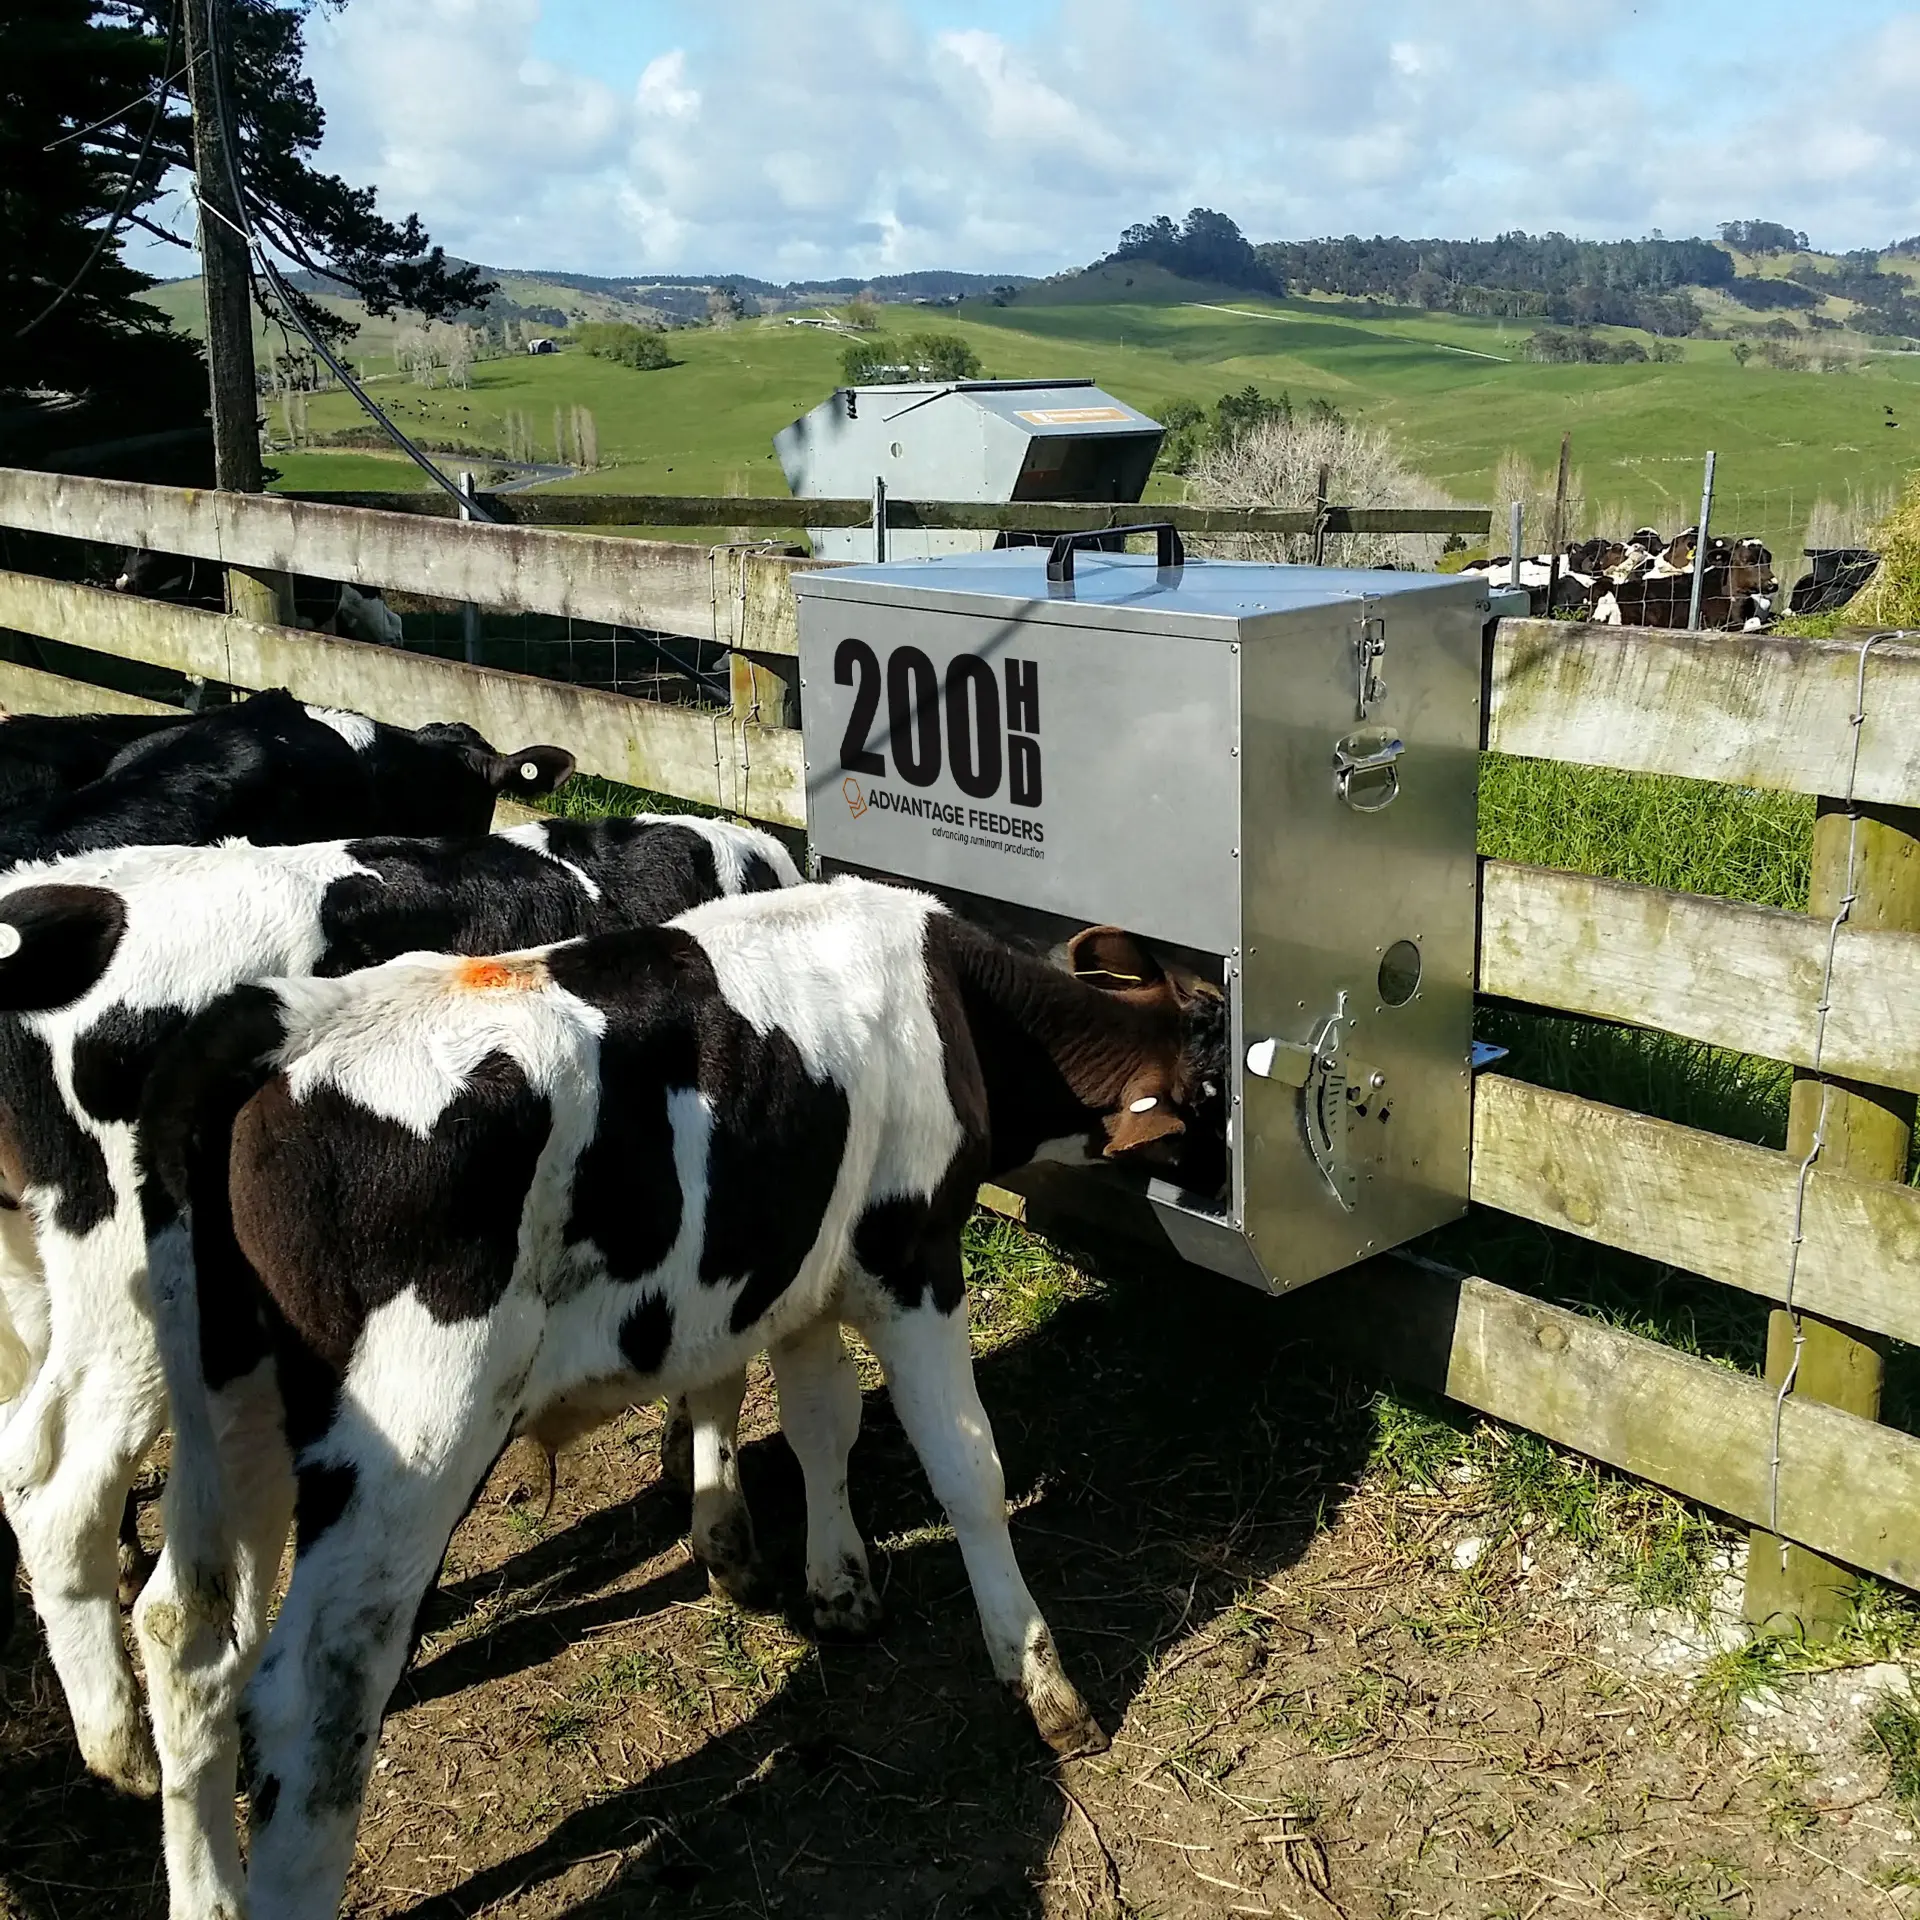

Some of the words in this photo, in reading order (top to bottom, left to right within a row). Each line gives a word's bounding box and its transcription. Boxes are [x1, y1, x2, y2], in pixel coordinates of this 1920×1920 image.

[834, 638, 1003, 799] 200
[868, 789, 964, 826] ADVANTAGE
[969, 809, 1044, 842] FEEDERS
[932, 827, 969, 845] advancing
[970, 836, 1003, 851] ruminant
[1004, 843, 1045, 860] production
